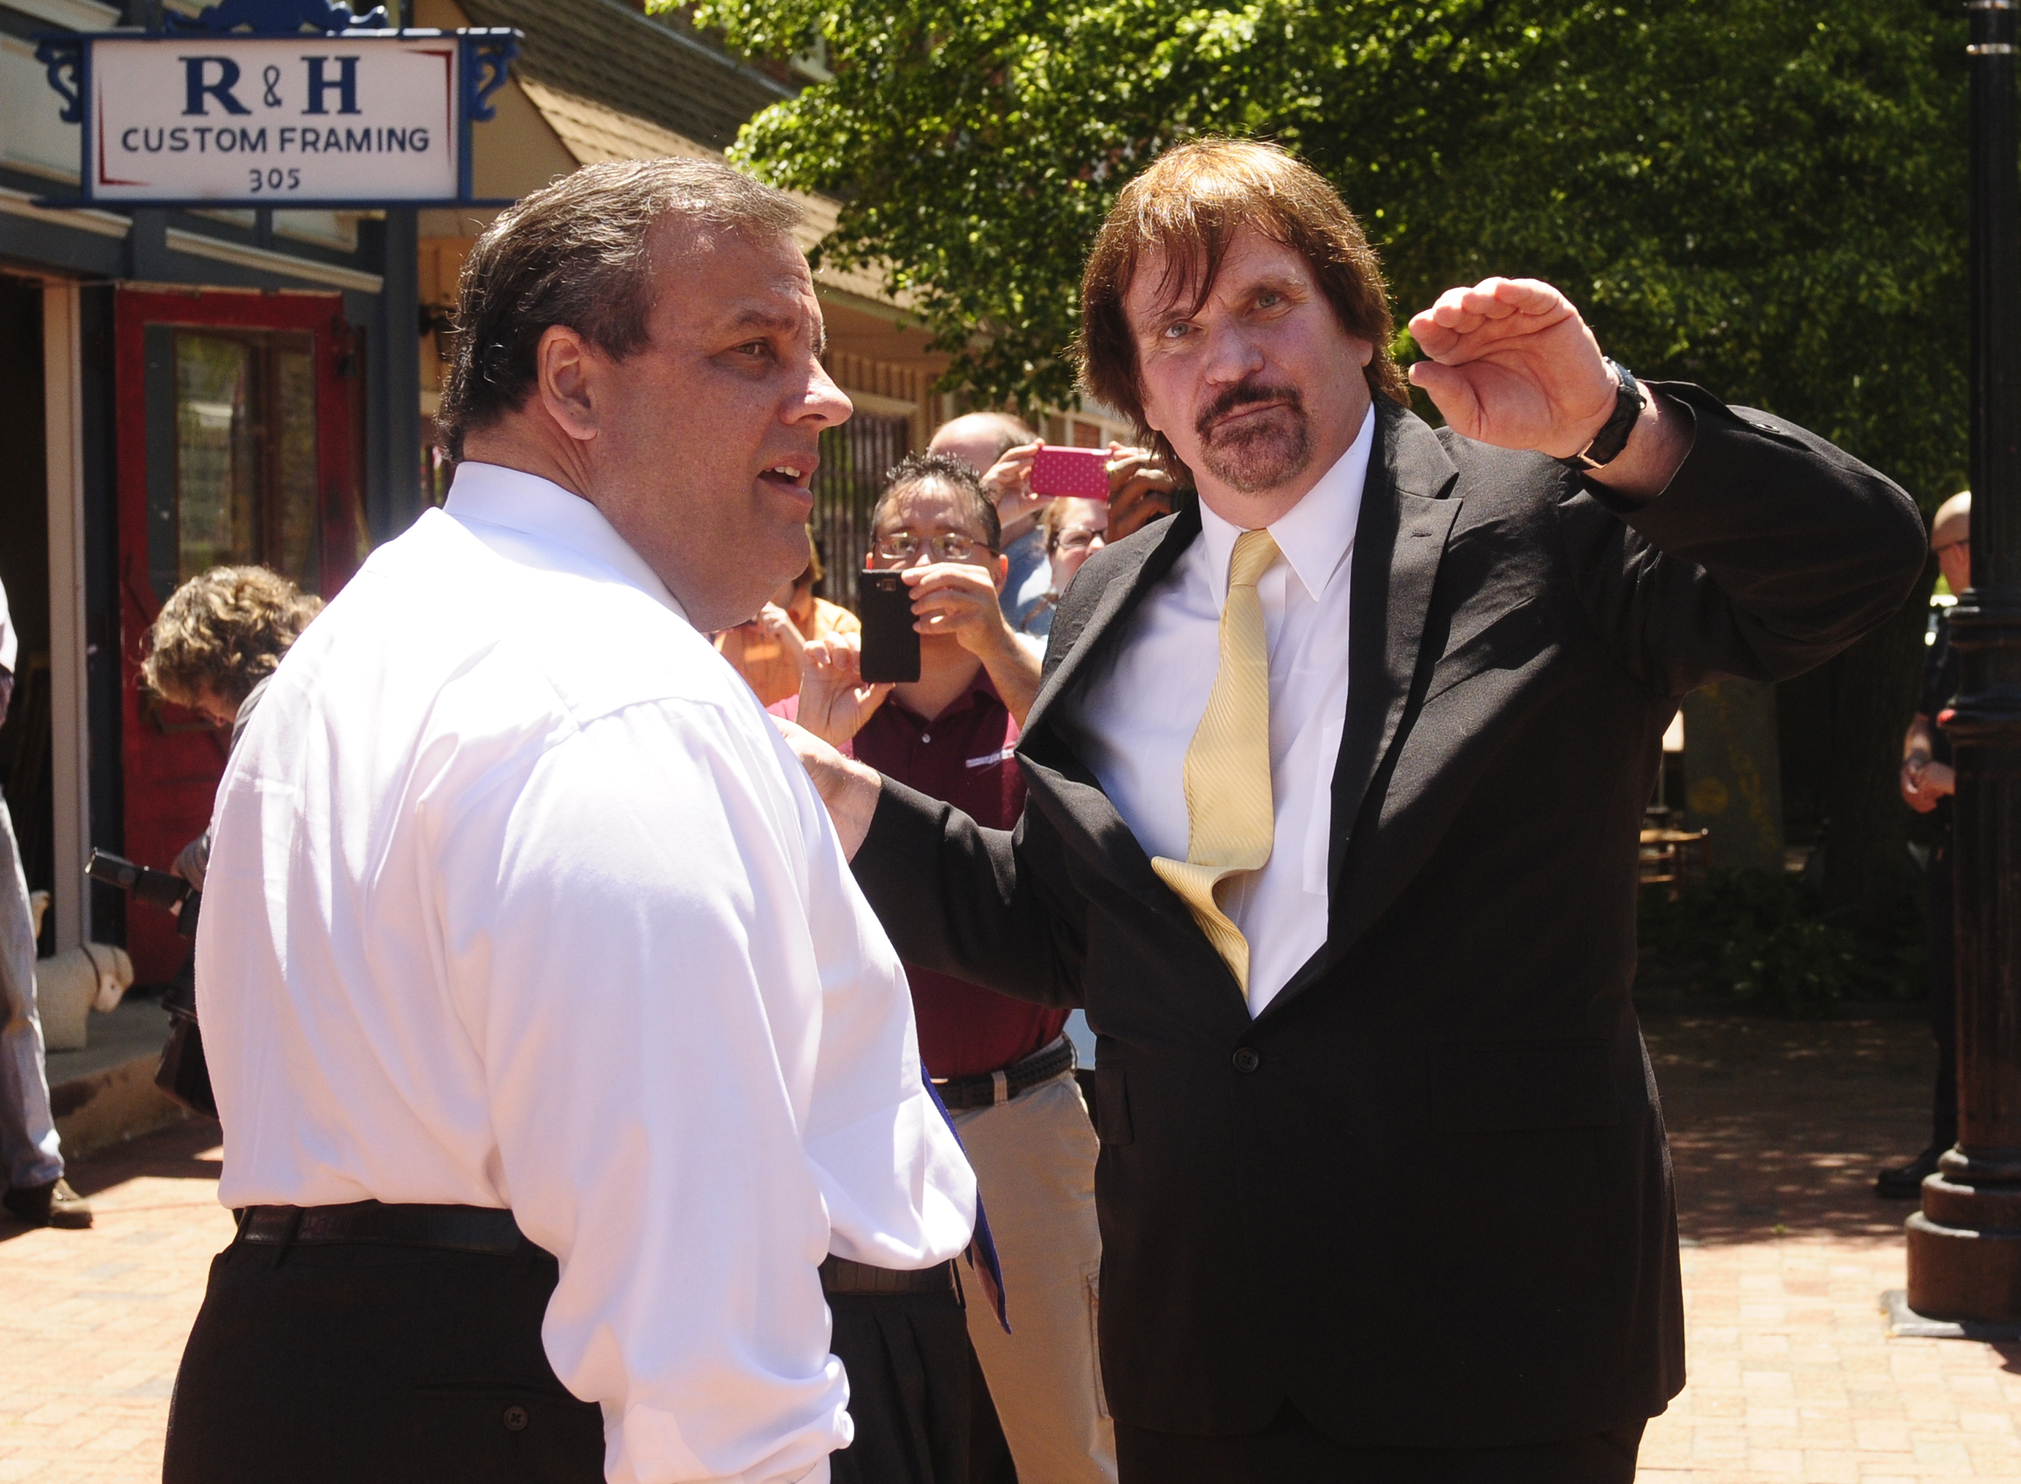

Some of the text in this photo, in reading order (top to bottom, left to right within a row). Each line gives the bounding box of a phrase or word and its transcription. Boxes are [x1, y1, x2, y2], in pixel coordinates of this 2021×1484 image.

[178, 55, 362, 116] R & H
[121, 127, 430, 153] CUSTOM FRAMING
[249, 168, 301, 193] 305
